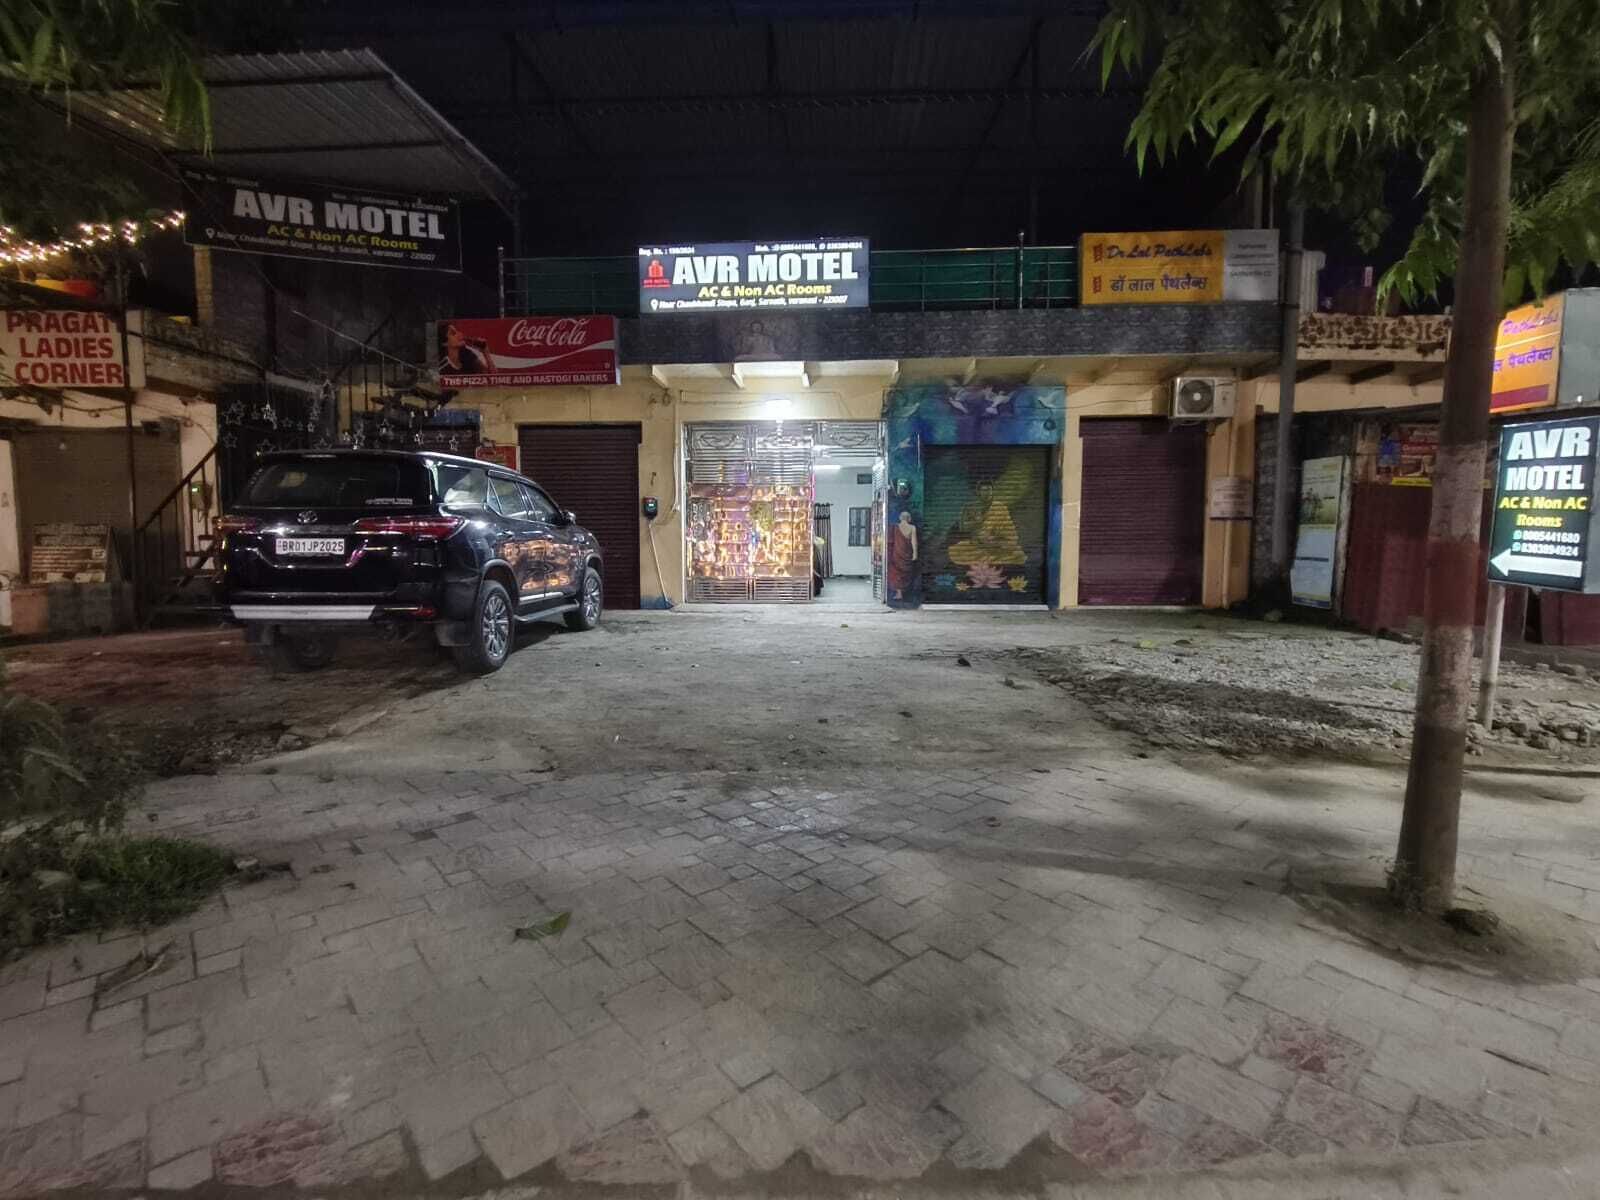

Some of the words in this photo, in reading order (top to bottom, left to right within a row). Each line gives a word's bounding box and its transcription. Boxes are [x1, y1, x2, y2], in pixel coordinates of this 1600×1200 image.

[232, 188, 315, 226] AVR
[323, 200, 445, 240] MOTEL
[266, 223, 289, 238] AC
[295, 227, 307, 239] &
[310, 229, 341, 243] Non
[346, 233, 368, 246] AC
[370, 235, 419, 251] Rooms
[672, 256, 740, 285] AVR
[747, 251, 859, 282] MOTEL
[698, 286, 719, 298] AC
[721, 286, 731, 298] &
[733, 285, 762, 298] Non
[764, 284, 785, 296] AC
[787, 283, 832, 295] Rooms
[19, 337, 114, 358] LADIES
[15, 362, 123, 384] CORNER
[463, 377, 488, 385] PIZZA
[490, 376, 512, 385] TIME
[513, 376, 531, 384] AND
[1506, 426, 1591, 462] AVR
[1504, 464, 1585, 492] MOTEL
[1499, 496, 1519, 510] AC
[1520, 496, 1531, 510] &
[1532, 496, 1562, 510] Non
[1564, 495, 1587, 510] AC
[1516, 513, 1563, 528] Rooms
[281, 540, 345, 553] BR01JP2025
